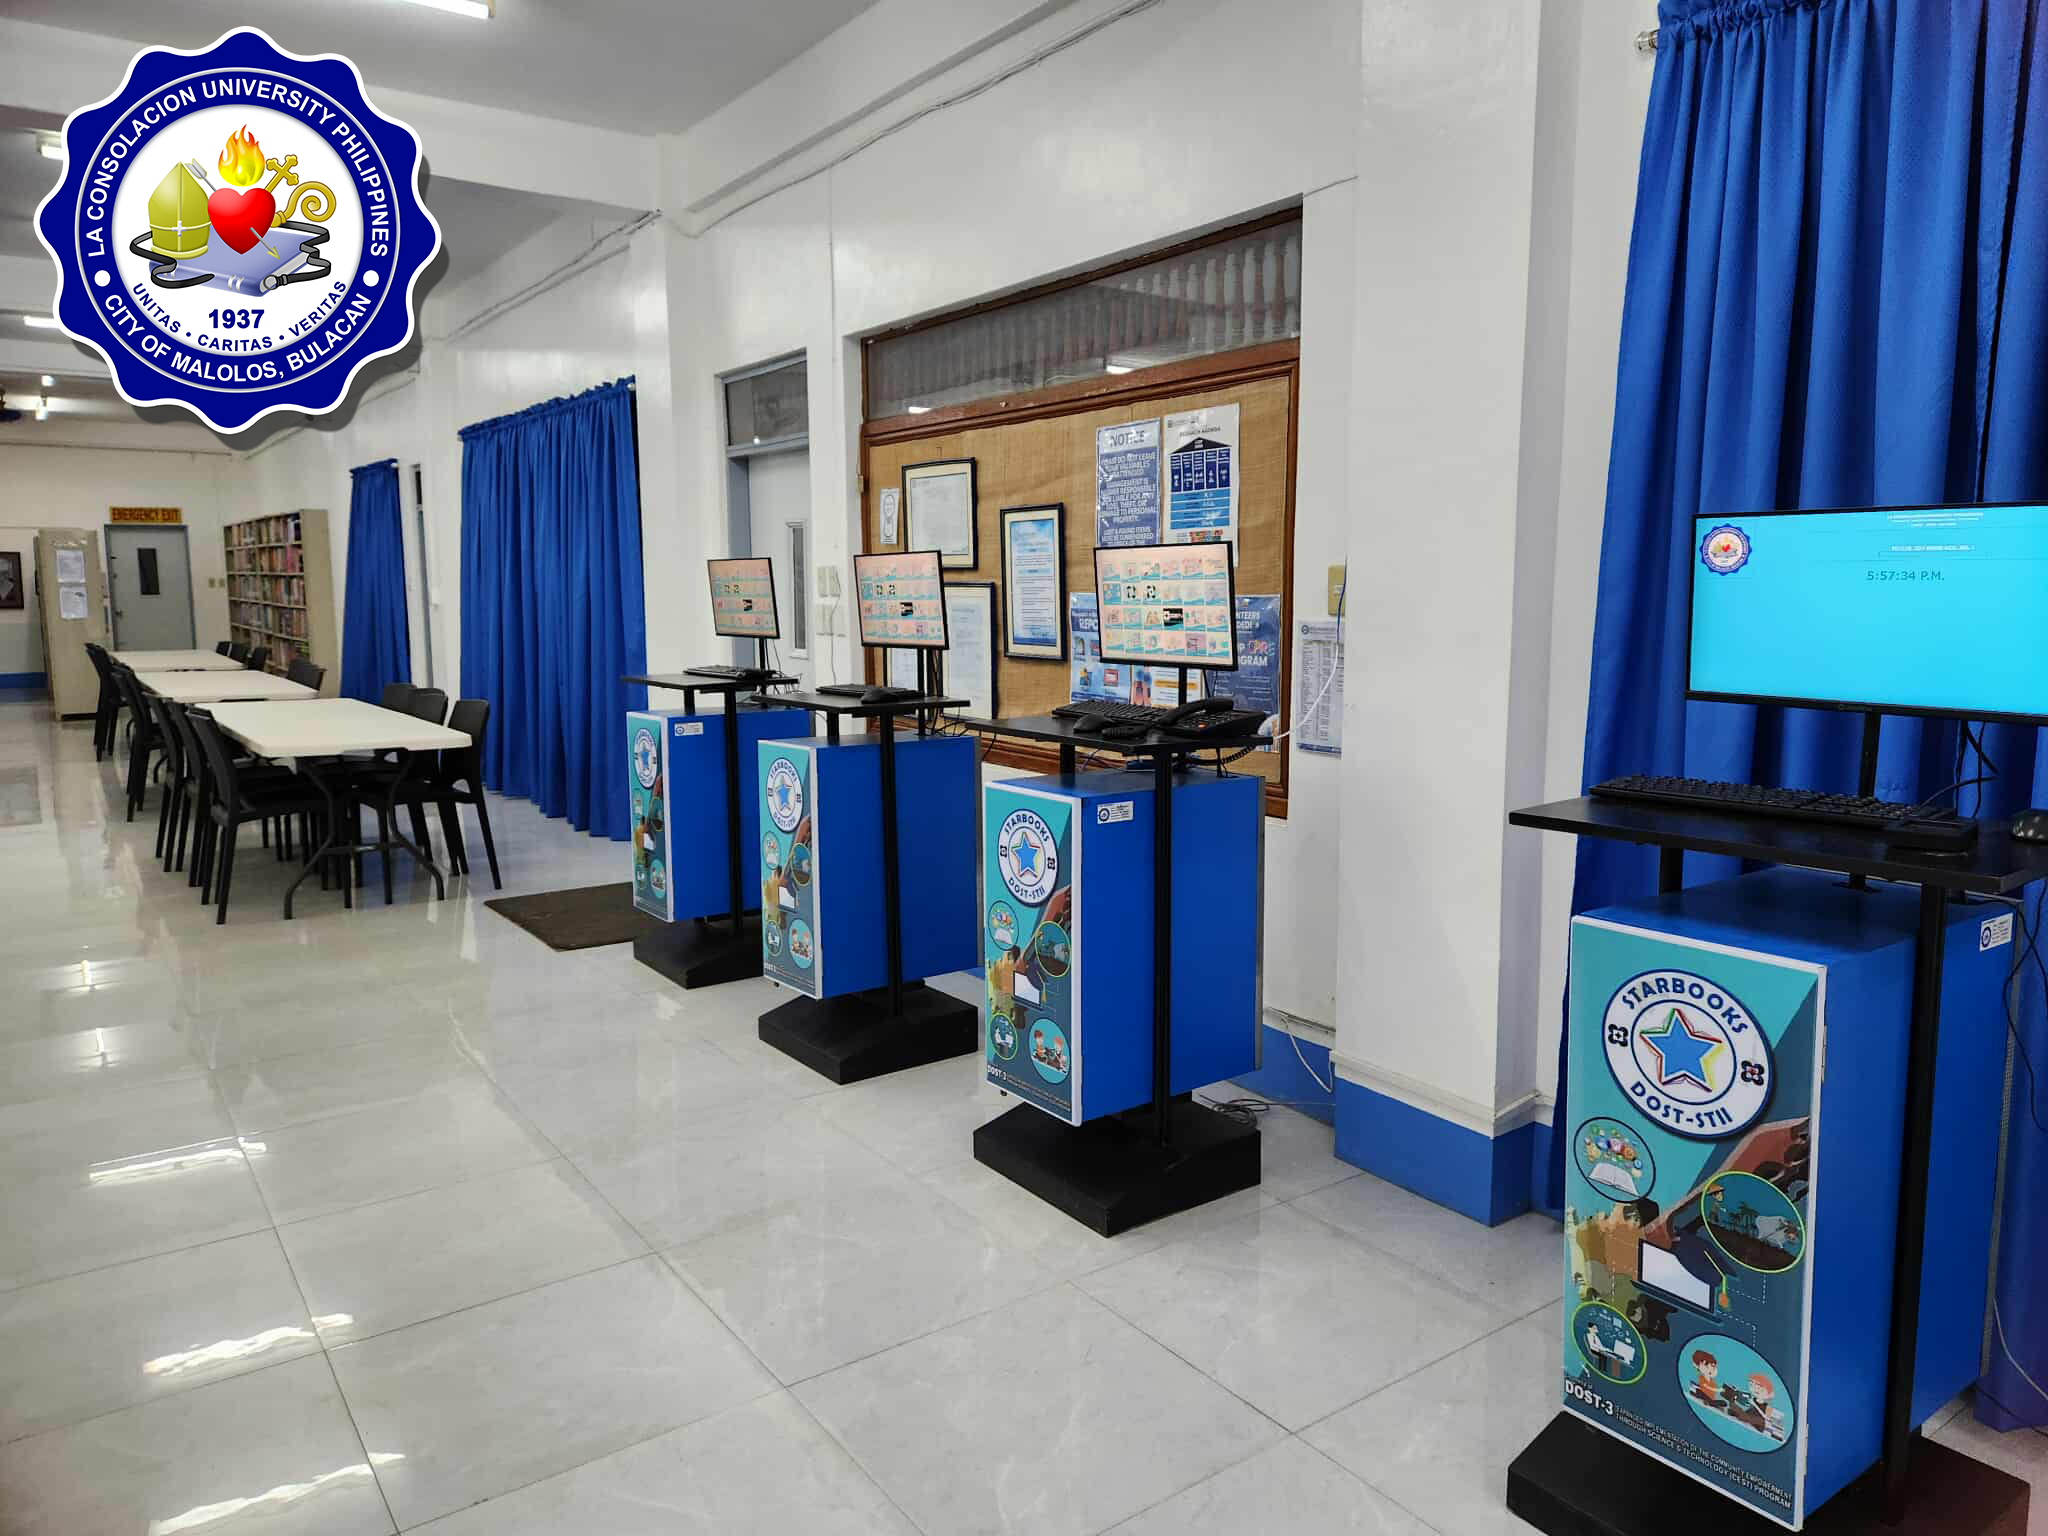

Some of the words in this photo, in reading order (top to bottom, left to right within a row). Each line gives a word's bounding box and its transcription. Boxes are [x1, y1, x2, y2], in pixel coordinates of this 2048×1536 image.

[1110, 430, 1145, 447] NOTICE
[1867, 570, 1916, 581] 5:57:34
[1920, 570, 1945, 581] P.M.
[1004, 814, 1050, 842] STARBOOKS
[1622, 977, 1749, 1034] STARBOOKS
[1630, 1081, 1734, 1128] DOST-STII
[1565, 1379, 1614, 1416] DOST-3
[1616, 1412, 1647, 1433] THROUGH
[1647, 1429, 1674, 1449] SCIENCE
[1683, 1448, 1728, 1475] TECHNOLOGY
[1754, 1486, 1792, 1509] PROGRAM
[1710, 1452, 1744, 1475] COMMUNITY
[1745, 1472, 1792, 1501] EMPOWERMENT
